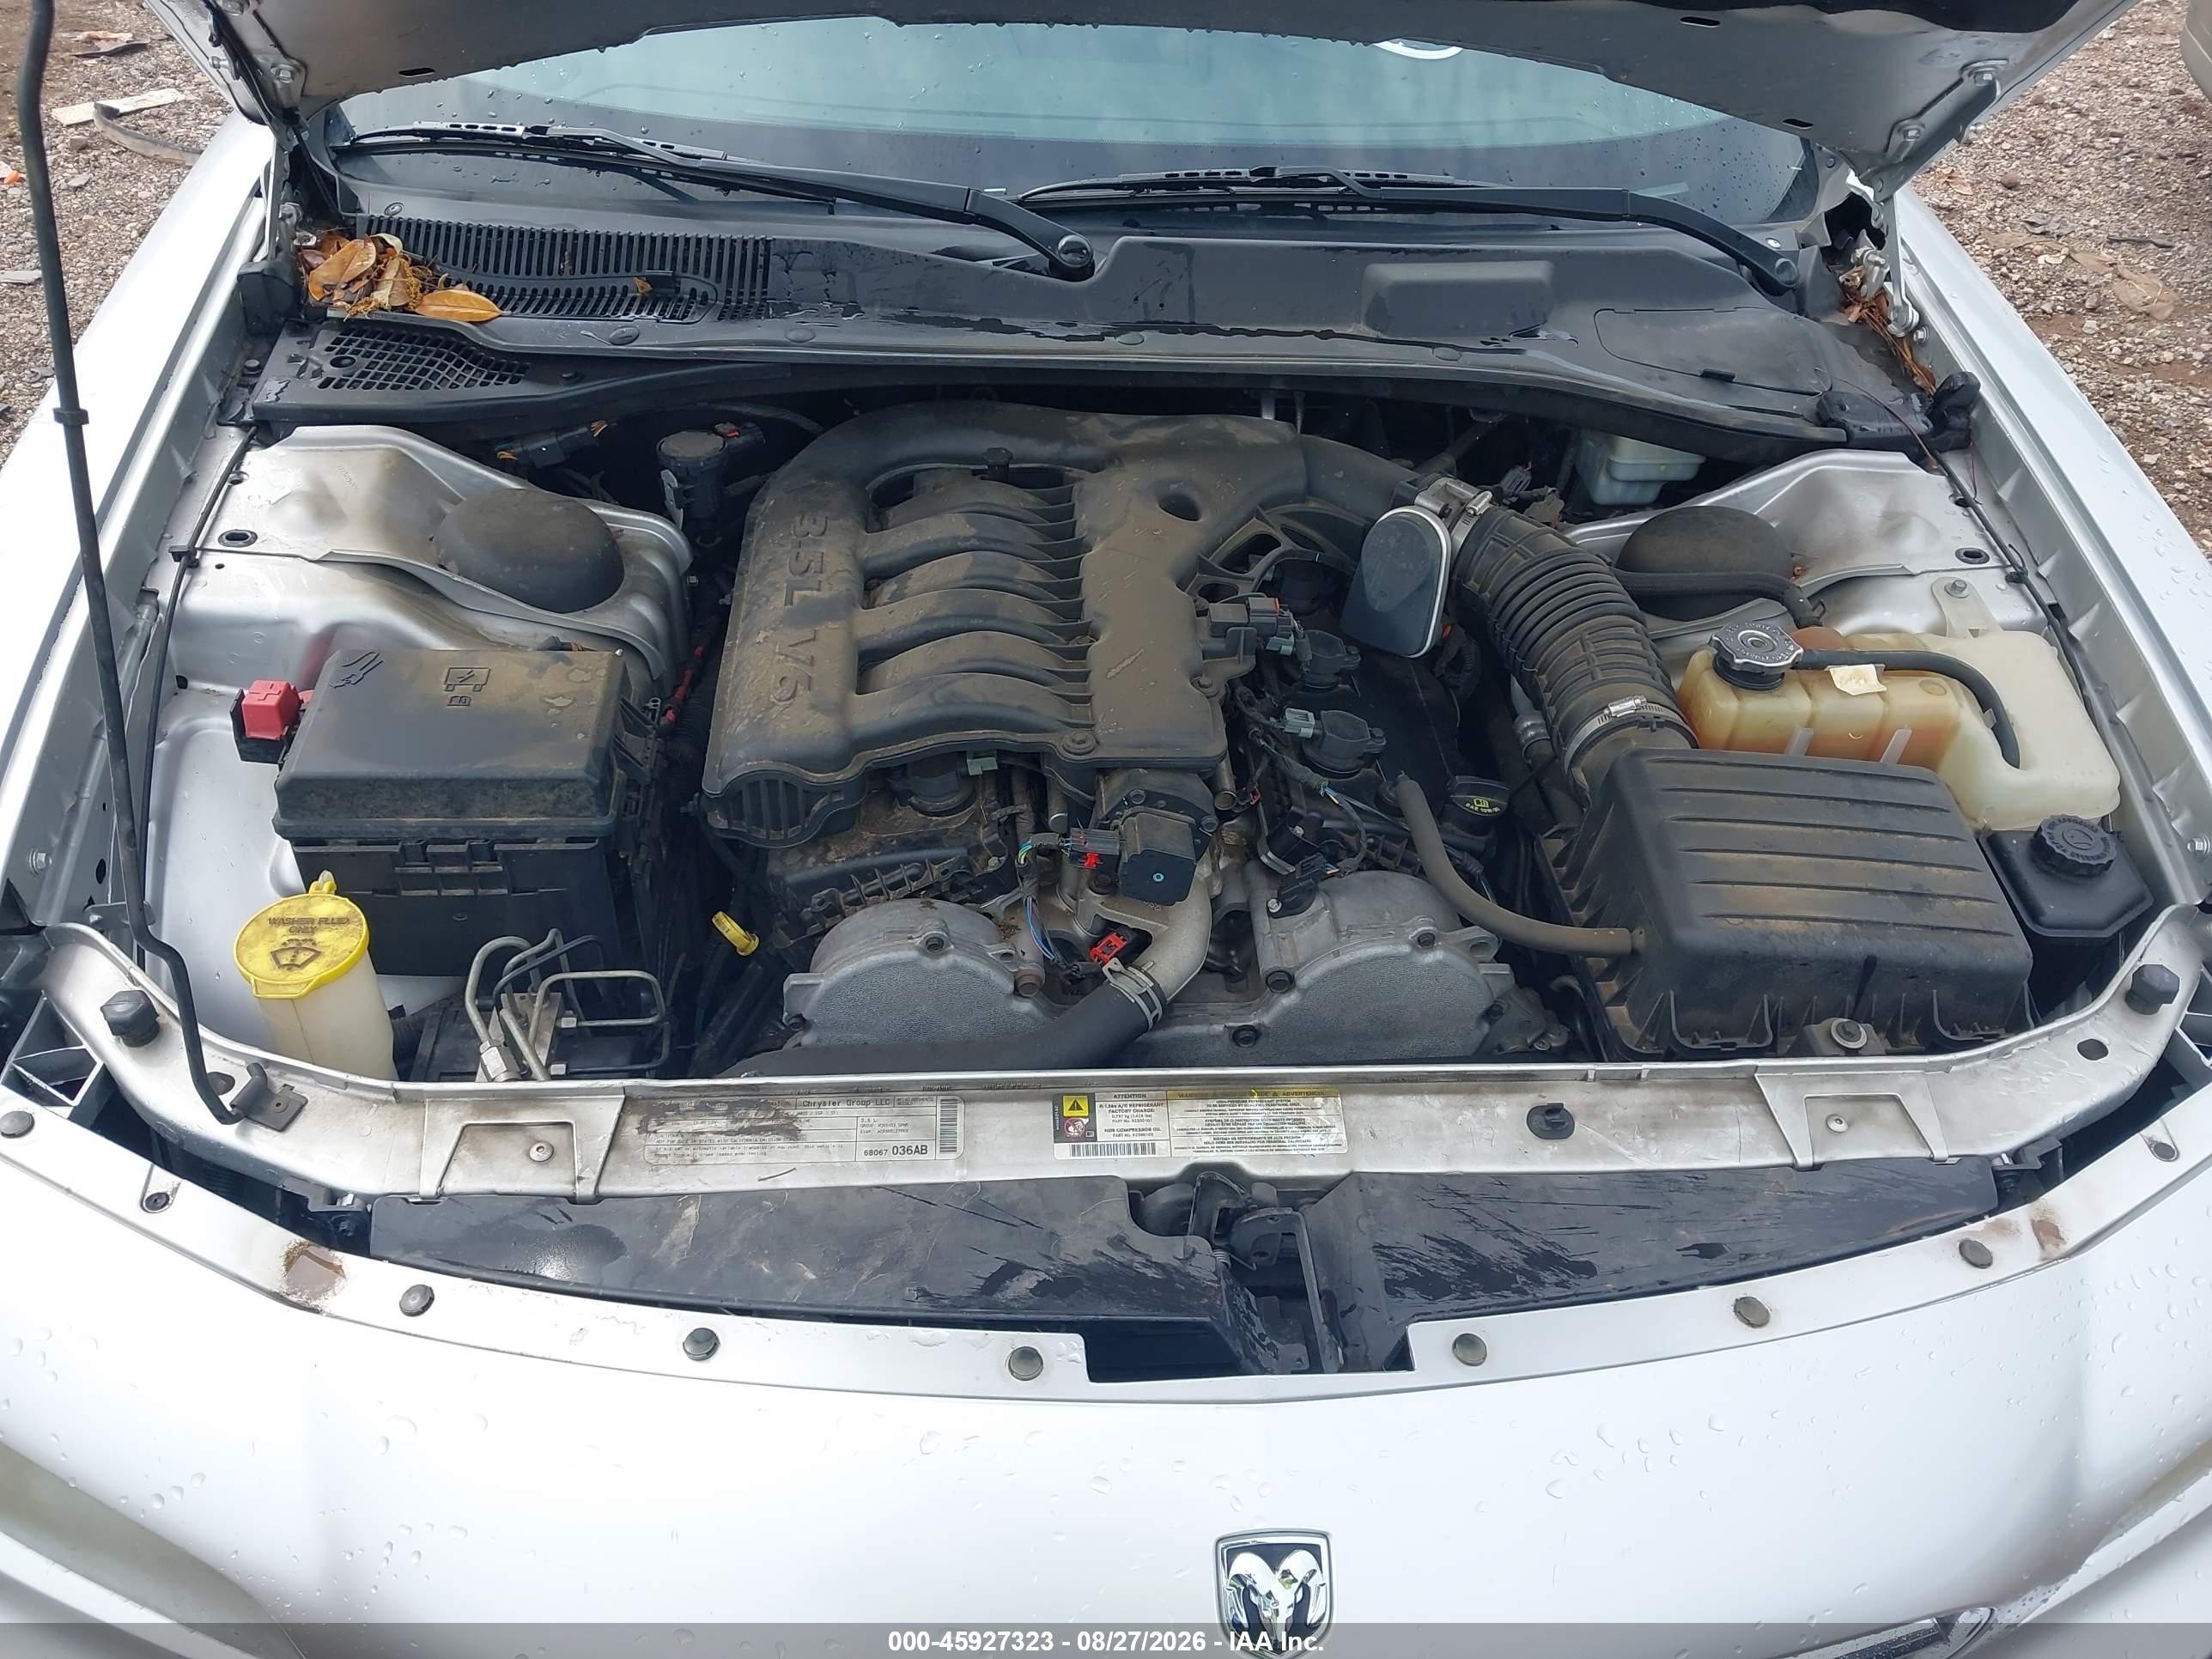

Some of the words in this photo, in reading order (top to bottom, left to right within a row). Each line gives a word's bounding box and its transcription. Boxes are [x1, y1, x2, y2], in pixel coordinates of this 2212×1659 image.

[770, 629, 817, 703] V6
[268, 916, 314, 926] WASHER
[318, 916, 350, 926] FLUID
[802, 1099, 841, 1109] Chrysler
[847, 1098, 872, 1108] Group
[891, 1145, 928, 1156] 036AB
